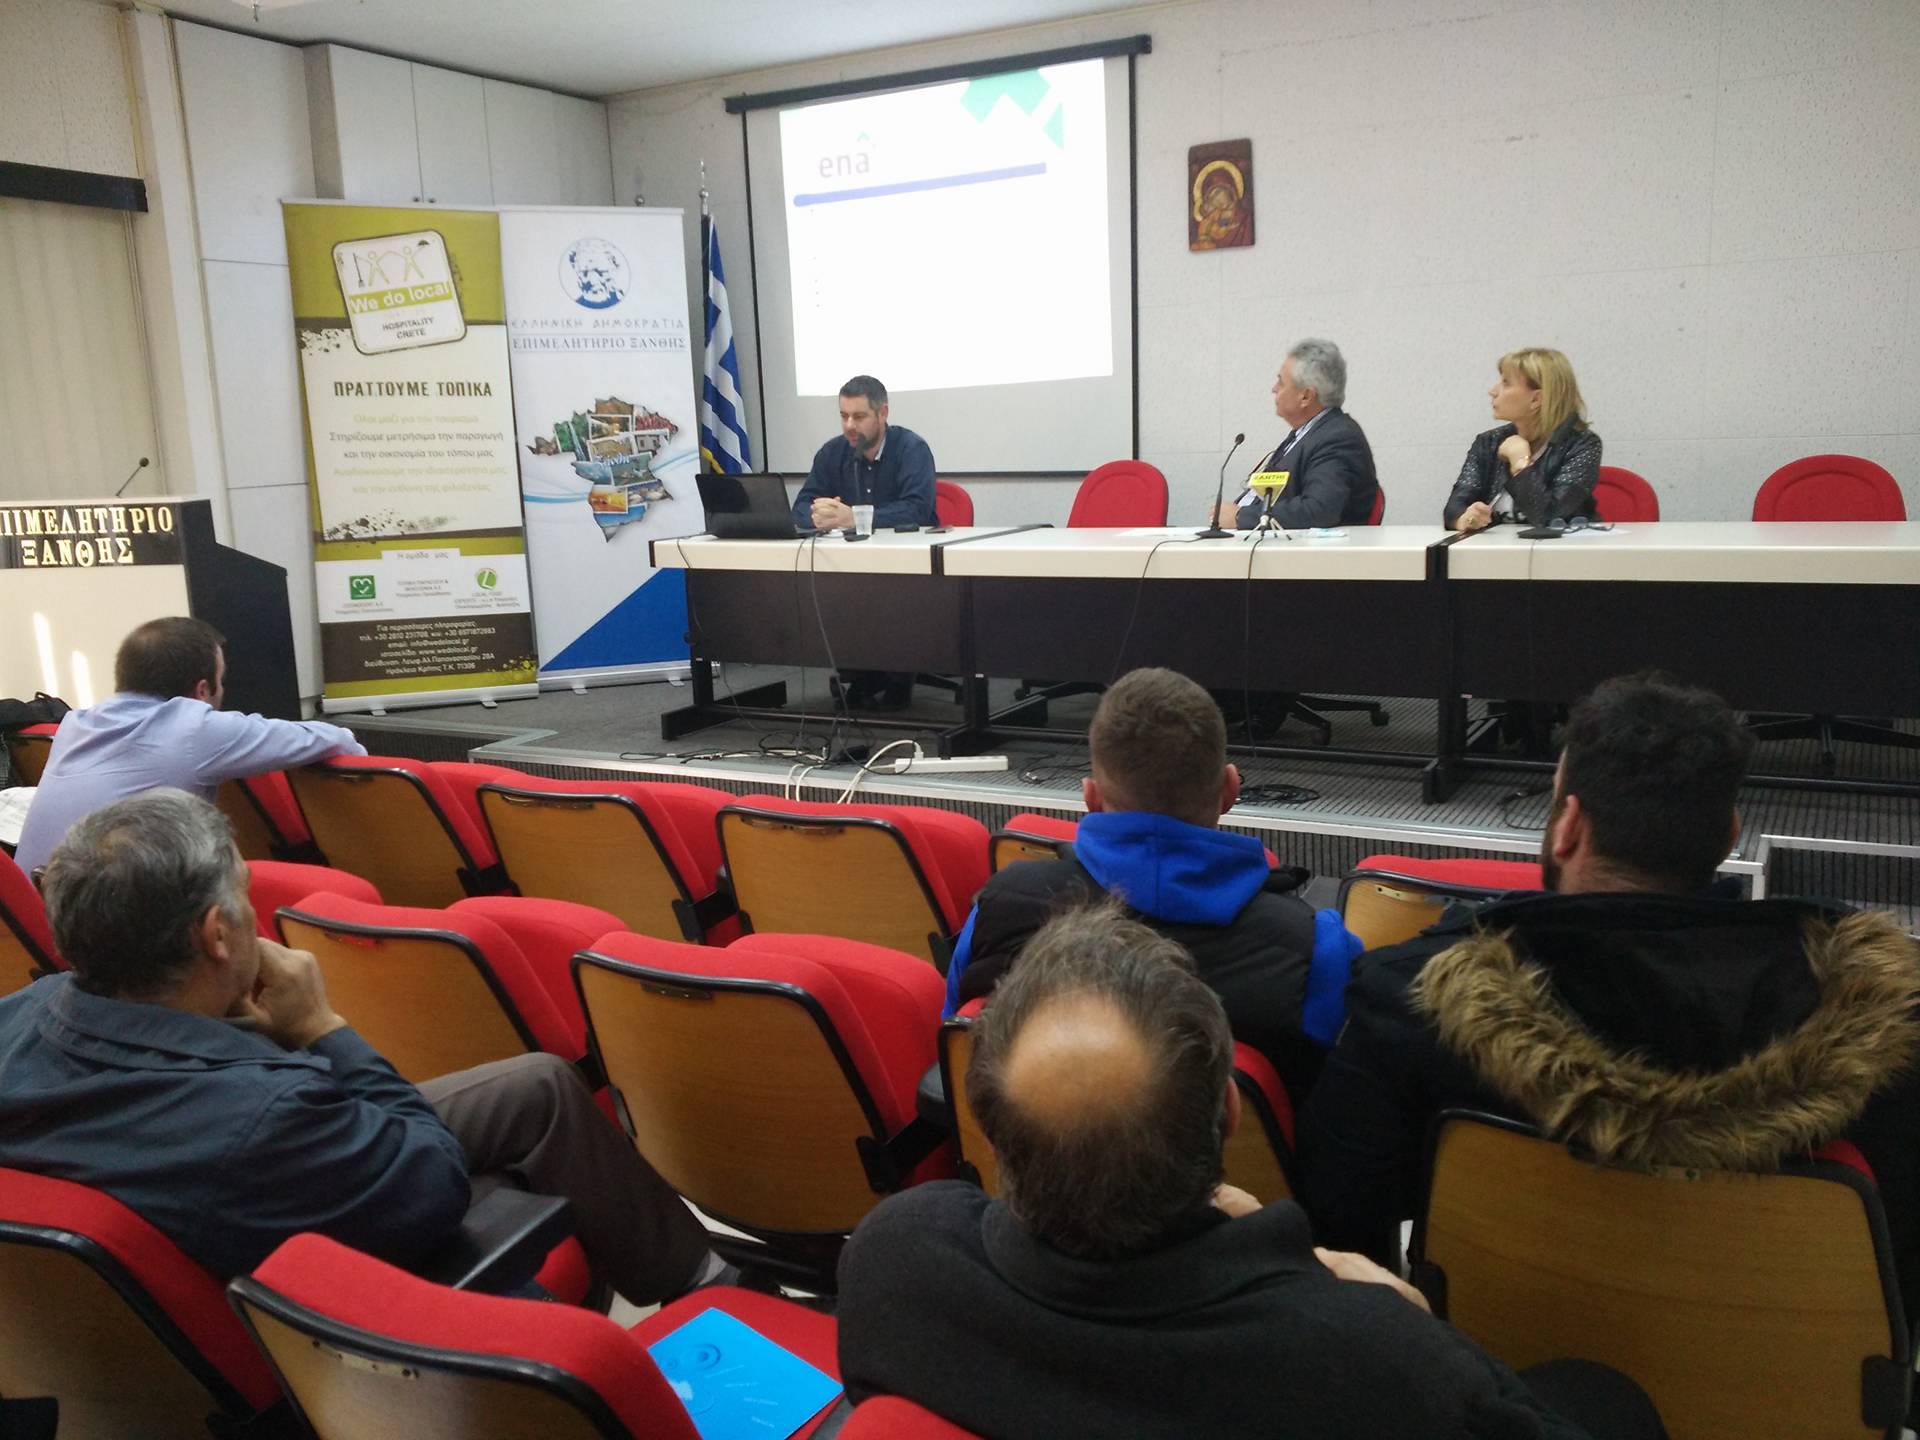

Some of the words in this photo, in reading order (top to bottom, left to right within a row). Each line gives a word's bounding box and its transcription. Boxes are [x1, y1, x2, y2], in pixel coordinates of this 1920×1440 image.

[349, 294, 379, 313] We
[383, 290, 405, 306] do
[408, 281, 449, 301] local
[382, 316, 434, 331] HOSPITALITY
[511, 318, 583, 329] ΕΛΛΗΝΙΚΗ
[592, 318, 685, 329] ΔΗΜΟΚΡΑΤΙΑ
[397, 327, 427, 339] CRETE
[513, 337, 625, 350] ΕΠΙΜΕΛΗΤΗΡΙΟ
[630, 338, 686, 349] ΞΑΝΘΗΣ
[334, 381, 430, 397] ΠΡΑΤΤΟΥΜΕ
[437, 381, 493, 397] ΤΟΠΙΚΑ
[21, 538, 134, 567] ΞΑΝΘΗΣ
